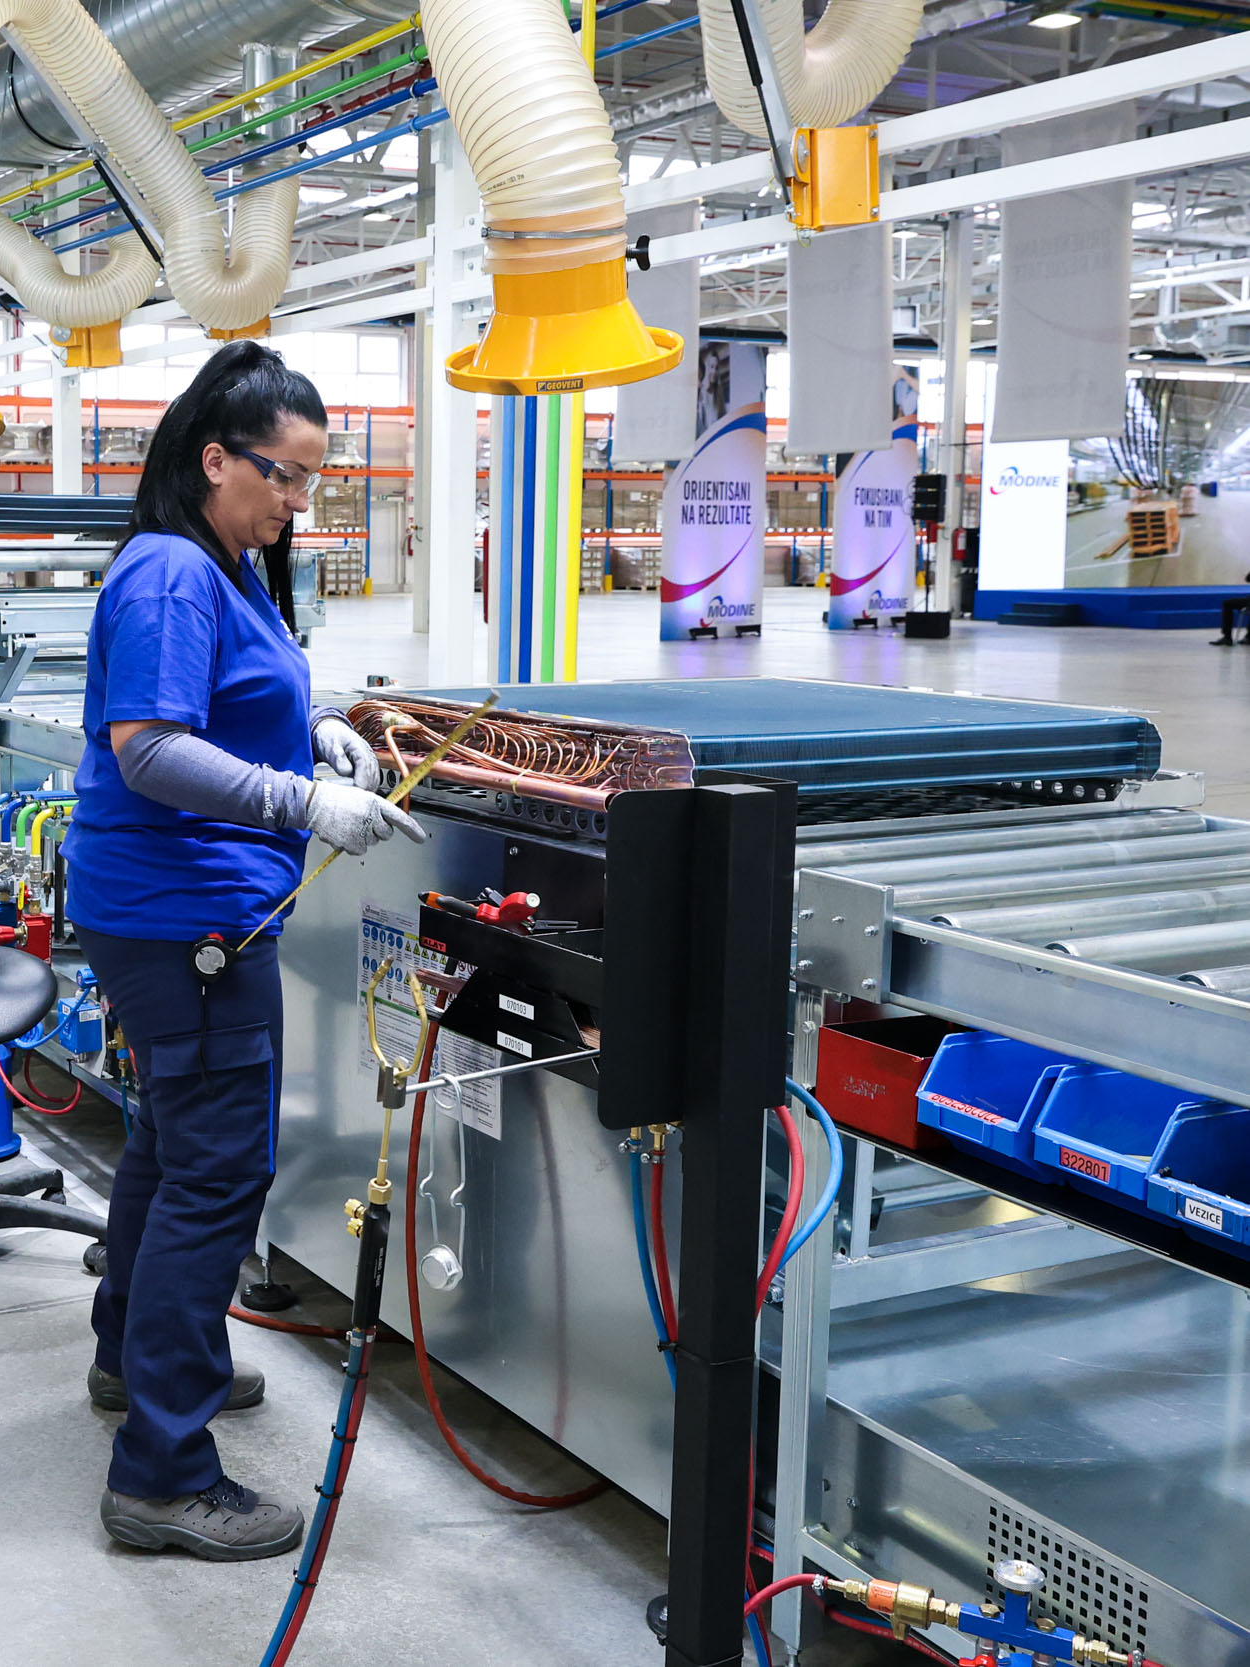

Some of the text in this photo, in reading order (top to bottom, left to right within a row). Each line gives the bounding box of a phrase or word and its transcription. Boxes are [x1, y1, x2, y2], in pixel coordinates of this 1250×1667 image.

[547, 379, 581, 390] GEOVENT
[999, 474, 1060, 488] MODINE
[683, 480, 751, 502] ORIJENTISANI
[854, 487, 903, 507] FOKUSIRANI
[681, 505, 752, 526] NA REZULTATE
[864, 510, 892, 528] NA TIM
[707, 604, 755, 618] MODINE
[867, 597, 908, 610] MODINE
[506, 996, 527, 1015] 070103
[504, 1033, 524, 1051] 070101
[1062, 1151, 1108, 1182] 322801
[1188, 1204, 1222, 1225] VEZICE
